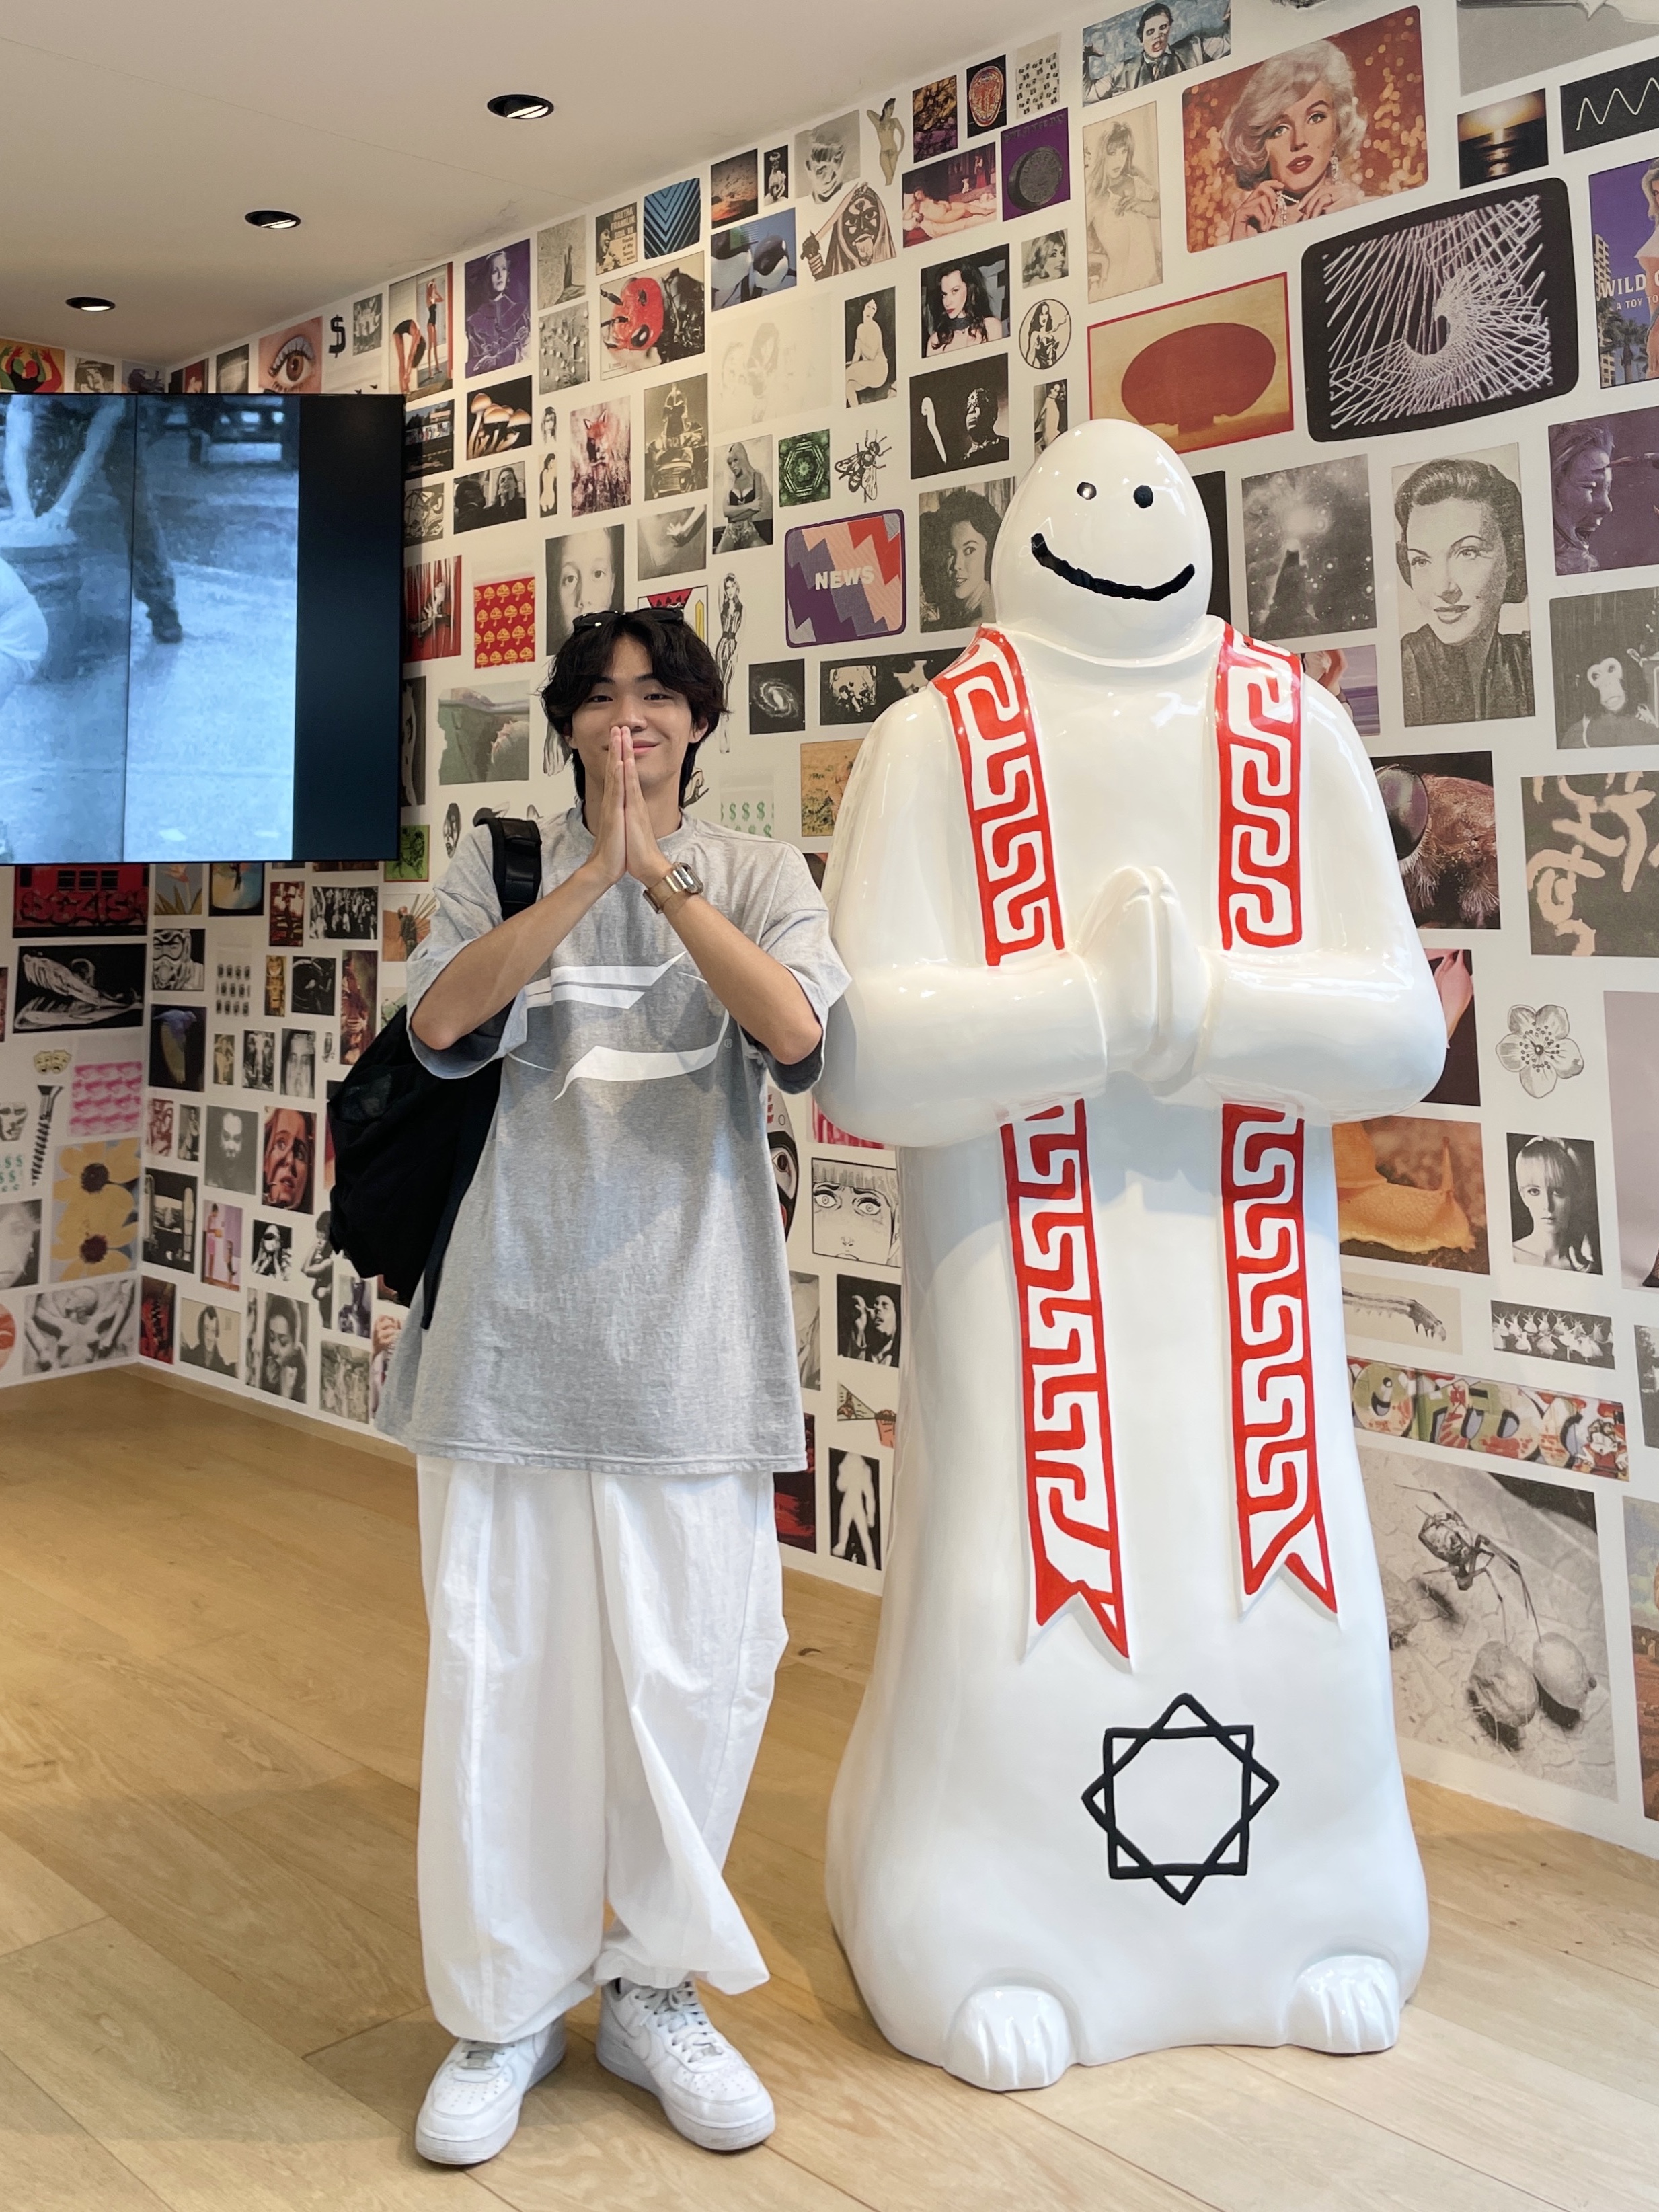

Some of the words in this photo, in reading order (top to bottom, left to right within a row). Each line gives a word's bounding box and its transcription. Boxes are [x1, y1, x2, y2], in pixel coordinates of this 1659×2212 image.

[1600, 274, 1646, 299] WILD
[1616, 302, 1622, 311] A
[1625, 297, 1643, 309] TOY
[815, 565, 874, 590] NEWS
